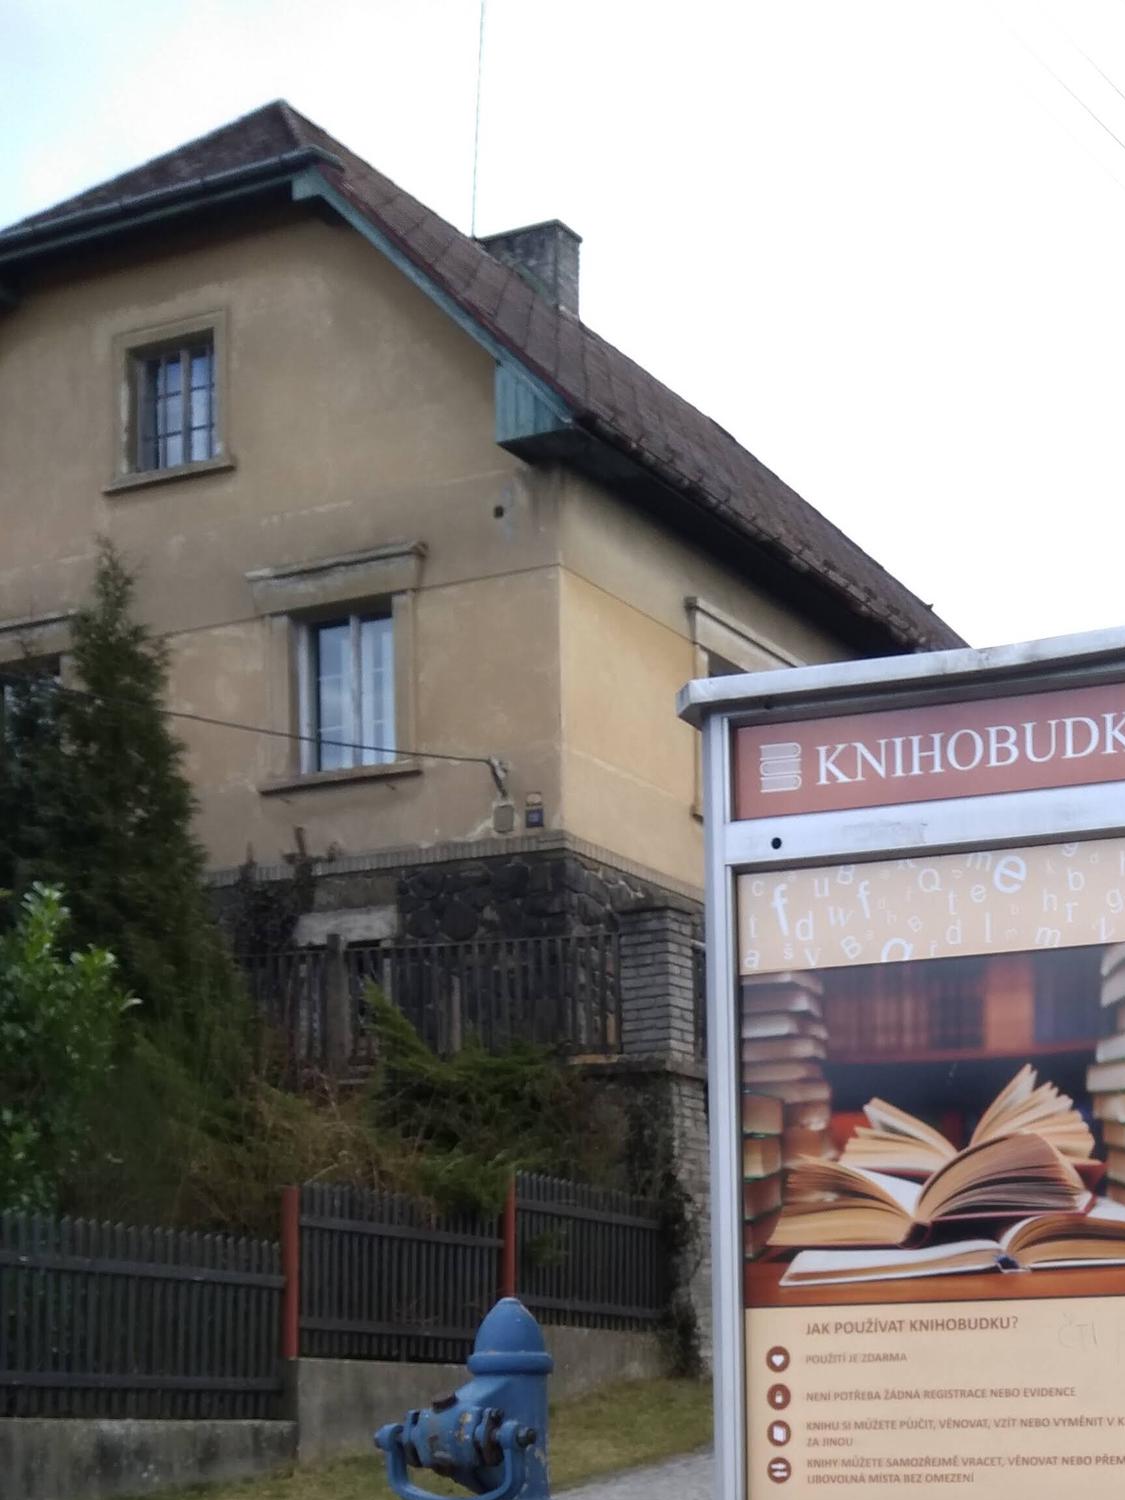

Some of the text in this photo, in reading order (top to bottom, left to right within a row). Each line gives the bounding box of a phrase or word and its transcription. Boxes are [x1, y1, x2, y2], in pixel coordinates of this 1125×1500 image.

[806, 1316, 1019, 1335] JAK POUŽÍVAT KNIHOBUDKU?
[861, 1353, 907, 1363] ZDARMA
[806, 1386, 1077, 1402] NENÍ POTŘEBA ŽÁDNÁ REGISTRACE NEBO EVIDENCE
[806, 1420, 839, 1431] KNIHU
[993, 1415, 1017, 1428] VZÍT
[1020, 1417, 1050, 1428] NEBO
[1053, 1414, 1103, 1427] VYMĚNIT
[1106, 1416, 1115, 1427] V
[822, 1436, 853, 1447] JINOU
[807, 1458, 838, 1469] KNIHY
[1008, 1454, 1058, 1466] VĚNOVAT
[1061, 1456, 1092, 1466] NEBO
[868, 1472, 900, 1484] MÍSTA
[903, 1473, 922, 1484] BEZ
[925, 1472, 975, 1484] OMEZENÍ
